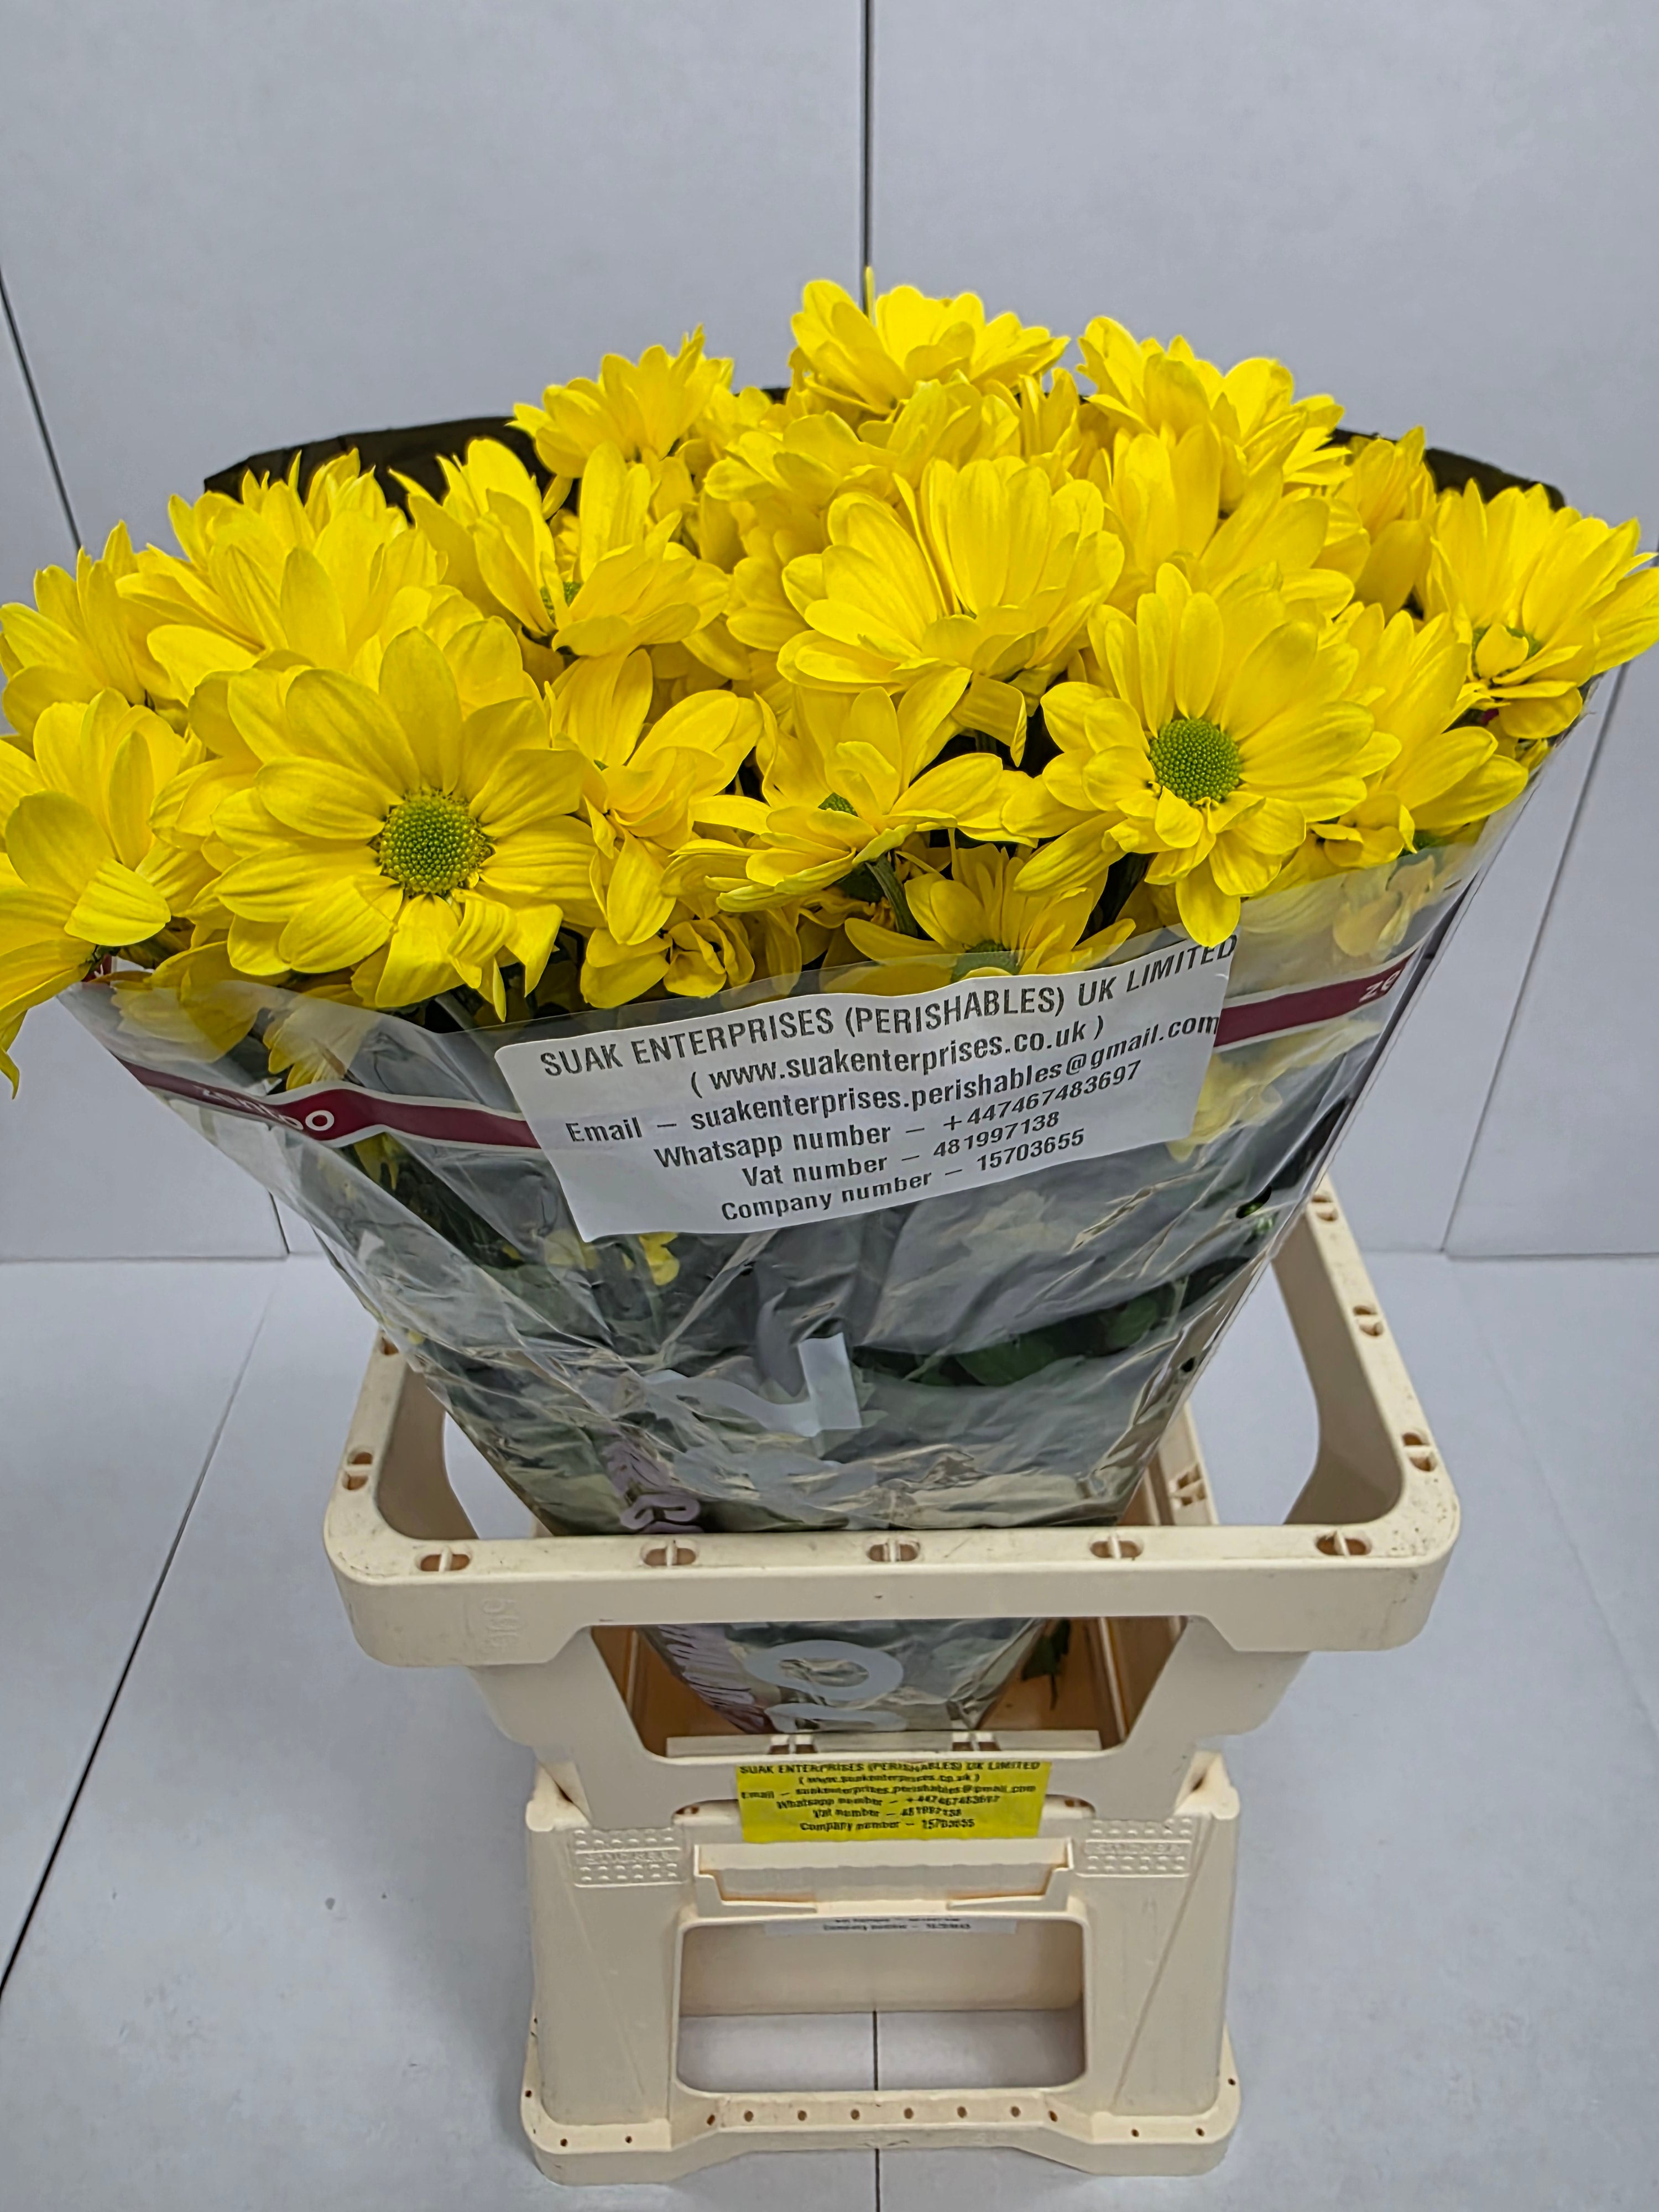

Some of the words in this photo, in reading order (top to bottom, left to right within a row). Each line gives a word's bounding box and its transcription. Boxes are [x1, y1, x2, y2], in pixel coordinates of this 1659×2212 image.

[540, 1043, 623, 1076] SUAK
[631, 1007, 834, 1064] ENTERPRISES
[846, 986, 1065, 1037] (PERISHABLES)
[1078, 975, 1117, 1006] UK
[1126, 935, 1237, 992] LIMITED
[565, 1117, 643, 1142] Email
[691, 1016, 1219, 1130] suakenterprises.perishables@gmail.com
[708, 1020, 1086, 1091] www.suakenterprises.co.uk
[654, 1134, 782, 1168] Whatsapp
[793, 1124, 890, 1151] number
[943, 1060, 1141, 1131] +447467483697
[742, 1165, 782, 1187] Vat
[793, 1157, 887, 1183] number
[933, 1112, 1060, 1157] 481997138
[722, 1192, 831, 1220] Company
[842, 1171, 932, 1202] number
[976, 1129, 1084, 1171] 15703655
[740, 1765, 774, 1773] SUAK
[779, 1763, 864, 1773] ENTERPRISES
[988, 1761, 1040, 1770] LIMITED
